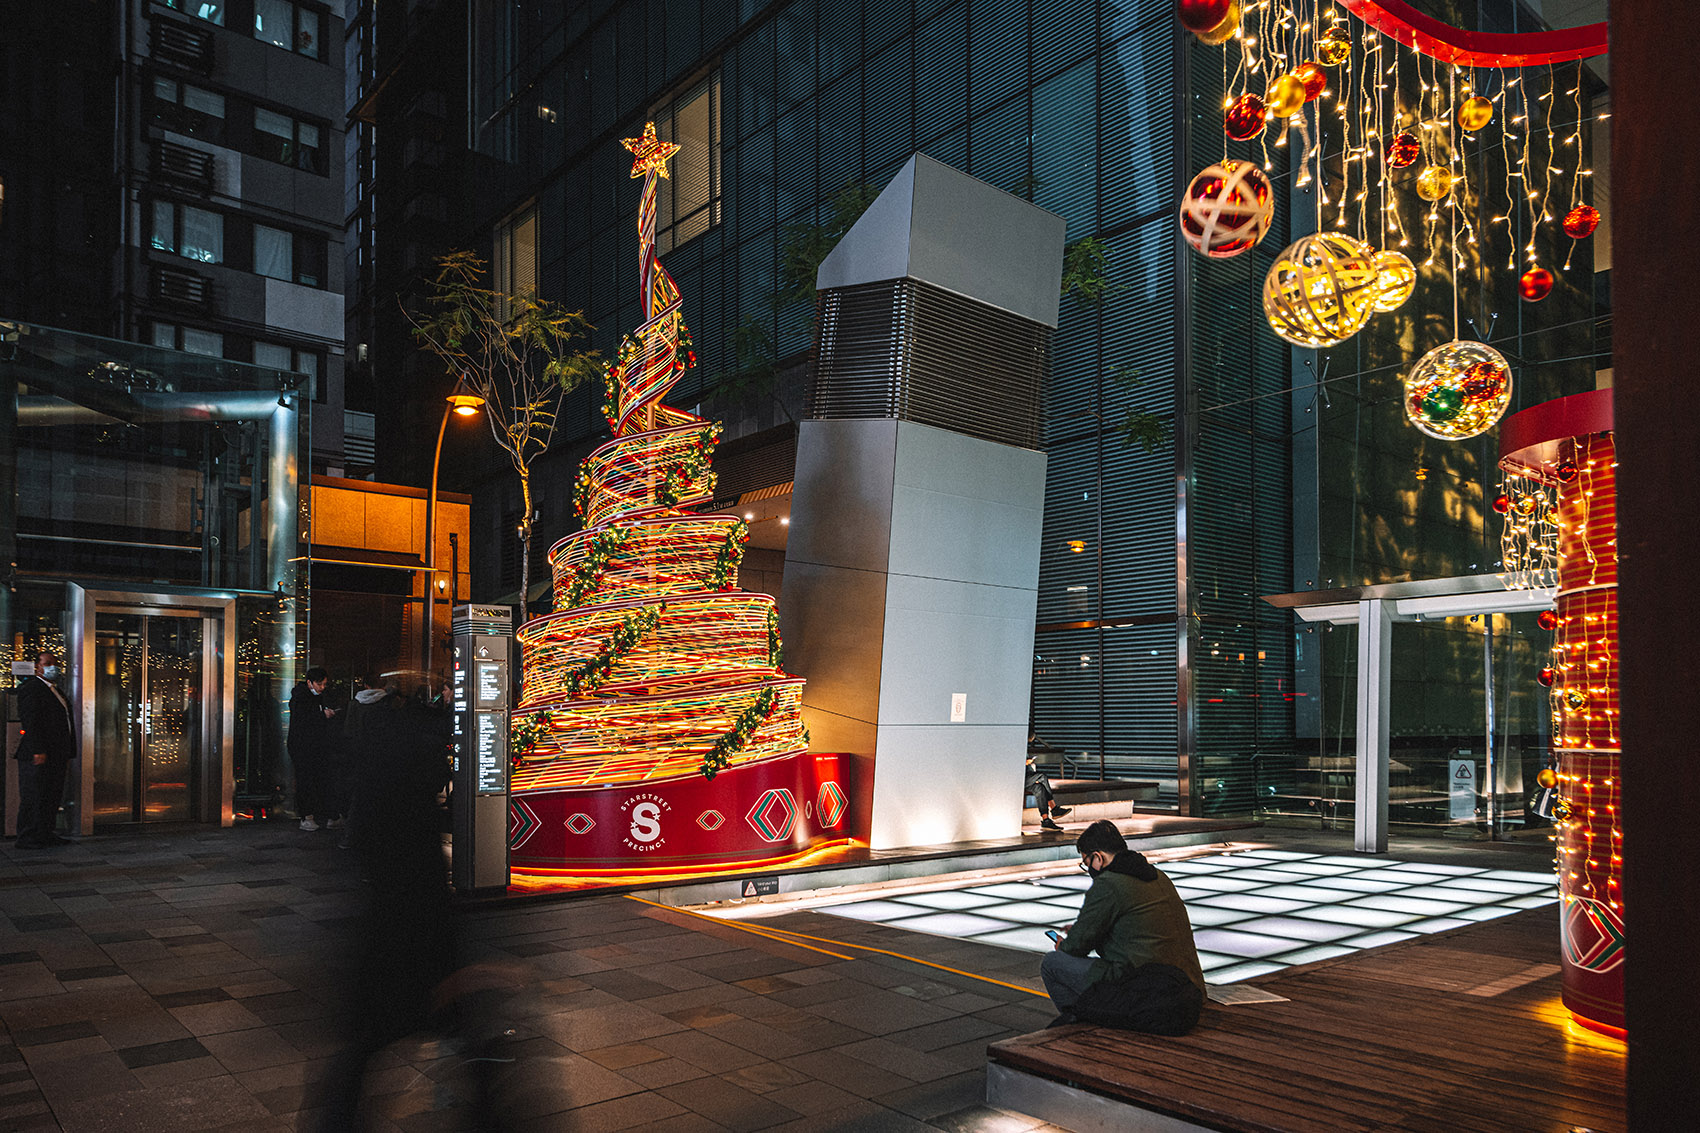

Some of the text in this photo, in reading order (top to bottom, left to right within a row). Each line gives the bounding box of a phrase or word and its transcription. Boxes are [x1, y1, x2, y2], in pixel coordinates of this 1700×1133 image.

[621, 794, 672, 812] STARSTREET
[631, 802, 661, 842] S
[623, 837, 666, 852] PRECINCT
